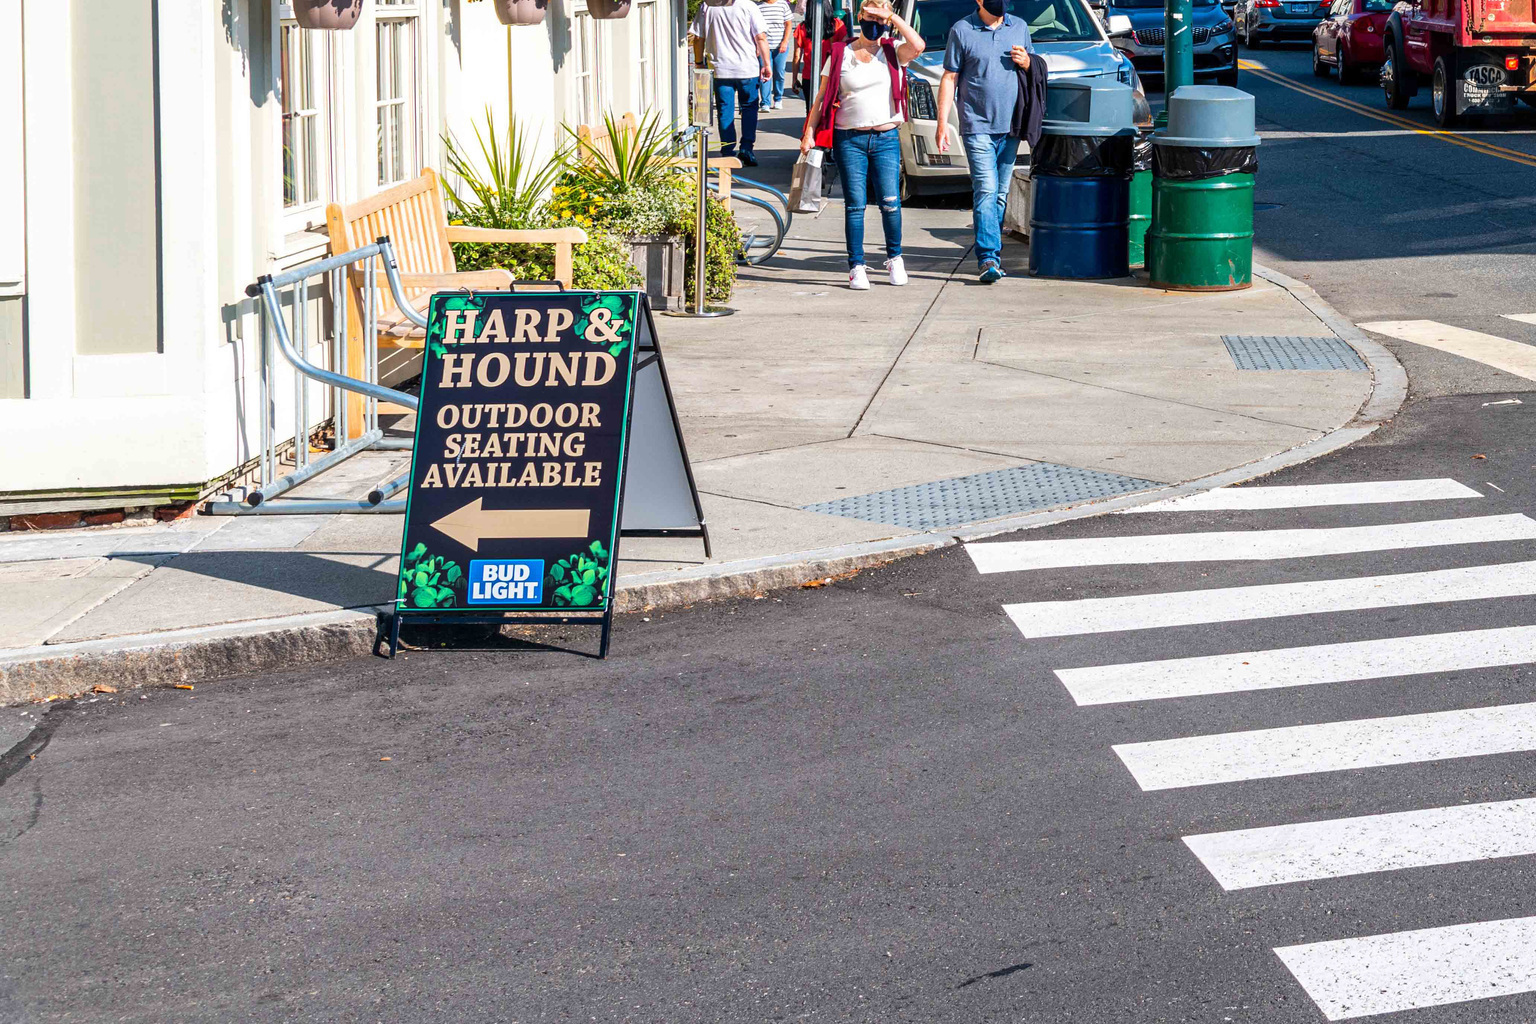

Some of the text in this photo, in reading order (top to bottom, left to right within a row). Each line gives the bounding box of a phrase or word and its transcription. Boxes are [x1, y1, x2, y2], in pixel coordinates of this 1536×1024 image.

[1469, 67, 1502, 84] TASCA
[442, 307, 624, 344] HARP &
[438, 352, 617, 388] HOUND
[436, 402, 602, 429] OUTDOOR
[444, 432, 586, 458] SEATING
[421, 462, 602, 488] AVAILABLE
[482, 564, 530, 582] BUD
[472, 581, 538, 599] LIGHT
